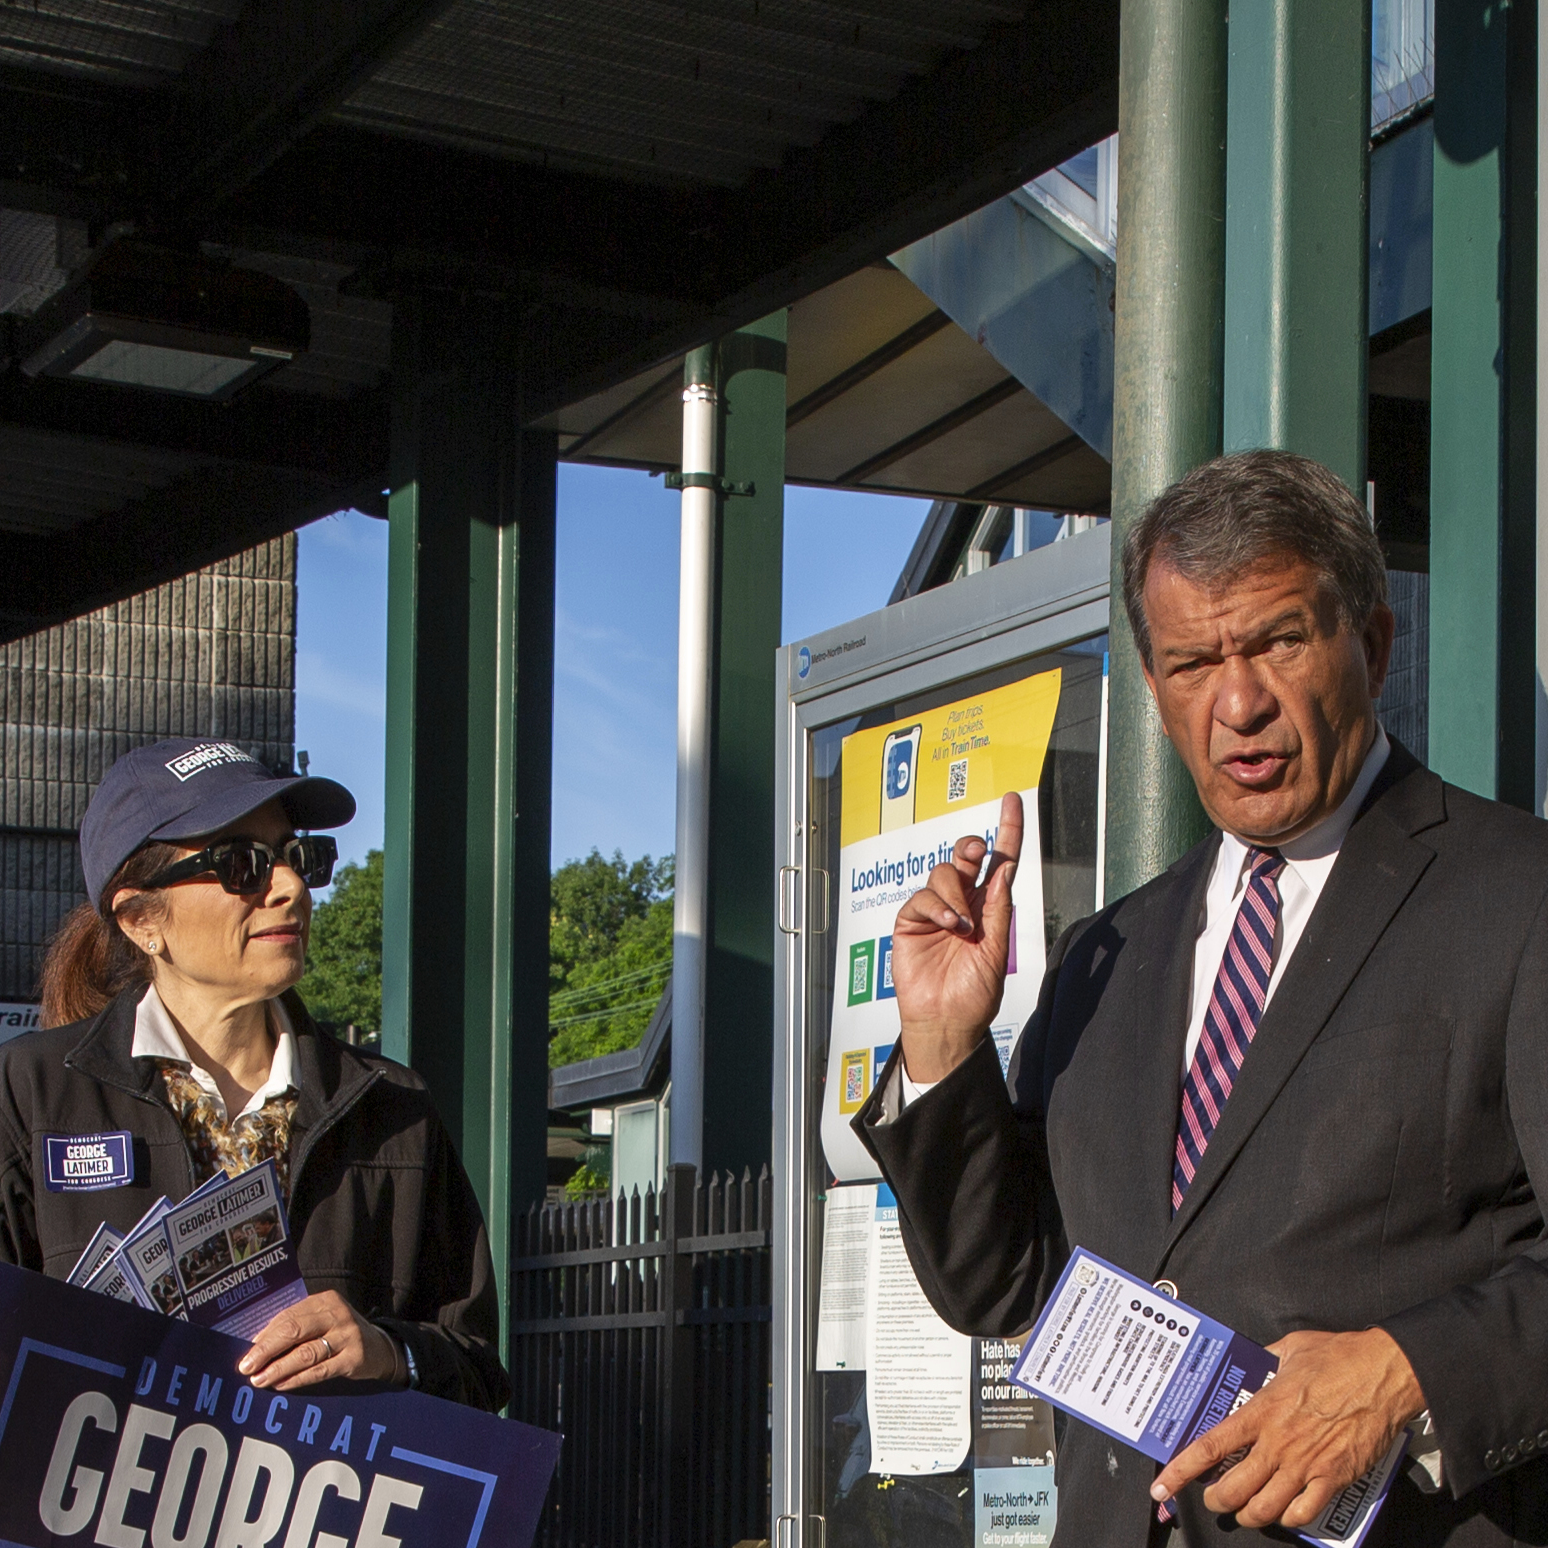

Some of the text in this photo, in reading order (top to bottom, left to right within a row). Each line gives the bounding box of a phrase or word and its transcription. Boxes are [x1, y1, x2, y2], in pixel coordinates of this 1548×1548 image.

[947, 711, 964, 724] Plan
[942, 727, 957, 741] Buy
[174, 747, 226, 774] GEORGE
[932, 747, 942, 762] All
[942, 745, 949, 758] in
[852, 859, 904, 892] Looking
[907, 852, 926, 877] for
[928, 852, 936, 871] a
[851, 899, 865, 913] Scan
[866, 897, 875, 909] the
[876, 892, 887, 906] QR
[888, 888, 907, 904] codes
[67, 1143, 107, 1159] GEORGE
[67, 1160, 108, 1174] LATIMER
[178, 1182, 262, 1236] GEORGE LATIMER
[142, 1238, 168, 1264] GEOR
[187, 1266, 249, 1310] PROGRESSIVE
[248, 1247, 288, 1277] RESULTS,
[217, 1275, 268, 1310] DELIVERED.
[981, 1340, 1020, 1359] Hate has
[981, 1360, 1014, 1382] no plac
[1224, 1365, 1246, 1390] NOT
[981, 1386, 994, 1400] on
[995, 1386, 1010, 1400] our
[134, 1356, 386, 1462] DEMOCRAT
[983, 1491, 1049, 1508] Metro-North JFK
[991, 1511, 1040, 1530] just got easier
[983, 1532, 1048, 1547] Get to your flight faster.
